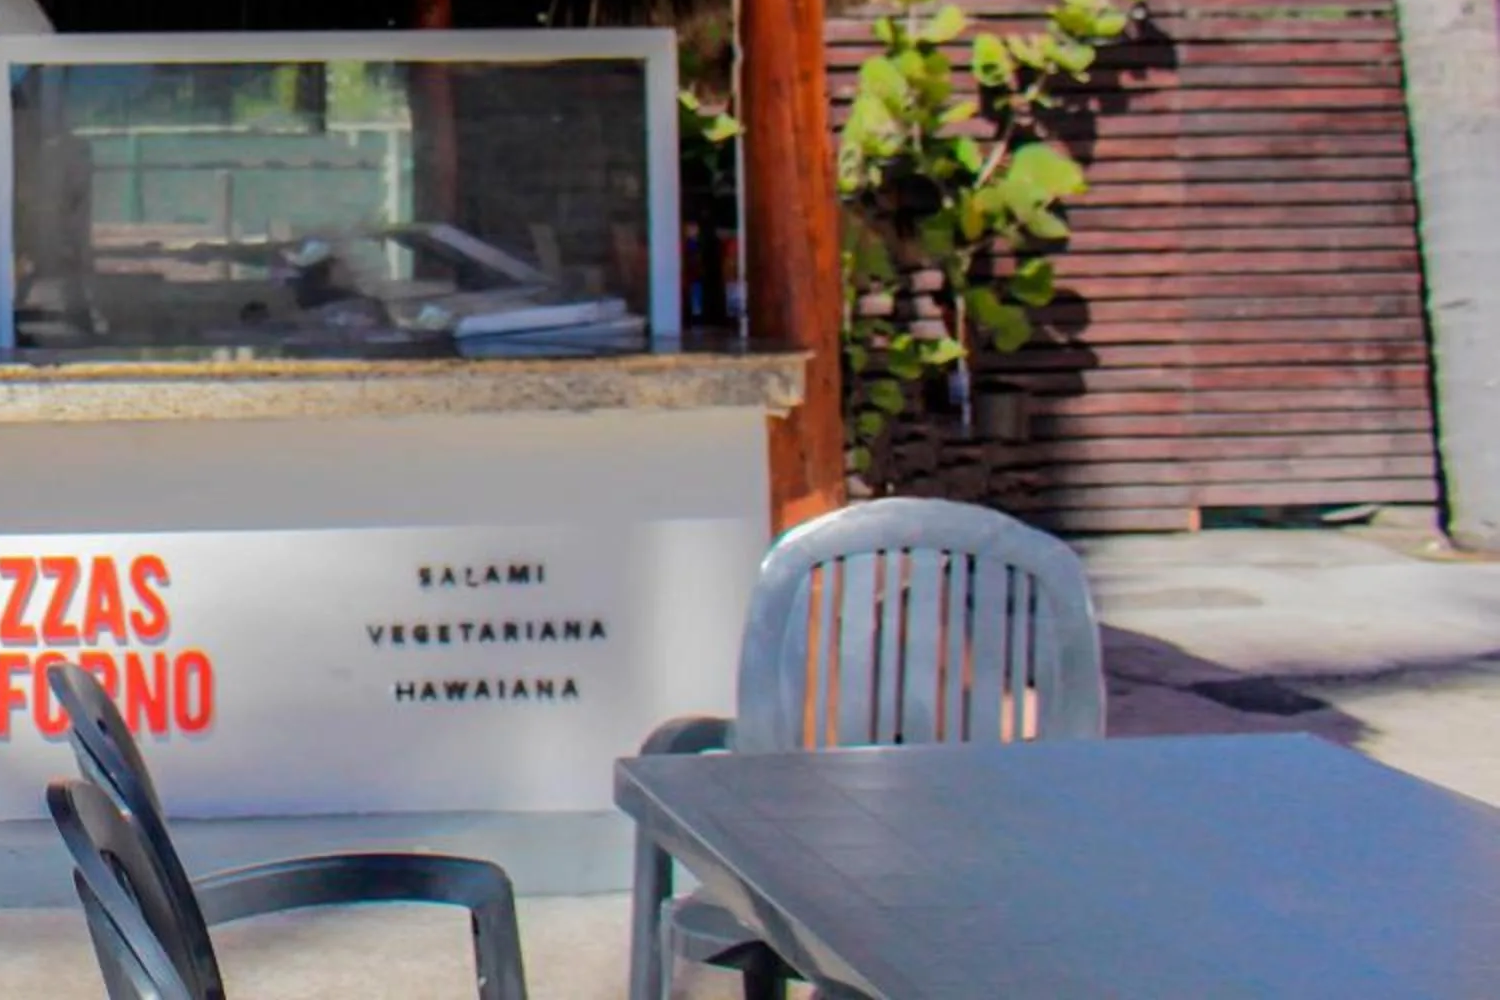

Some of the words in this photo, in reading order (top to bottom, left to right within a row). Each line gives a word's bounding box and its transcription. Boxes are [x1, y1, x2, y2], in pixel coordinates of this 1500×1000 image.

[418, 564, 546, 588] SALAMI
[366, 619, 607, 645] VEGETARIANA
[395, 677, 580, 701] HAWAIANA
